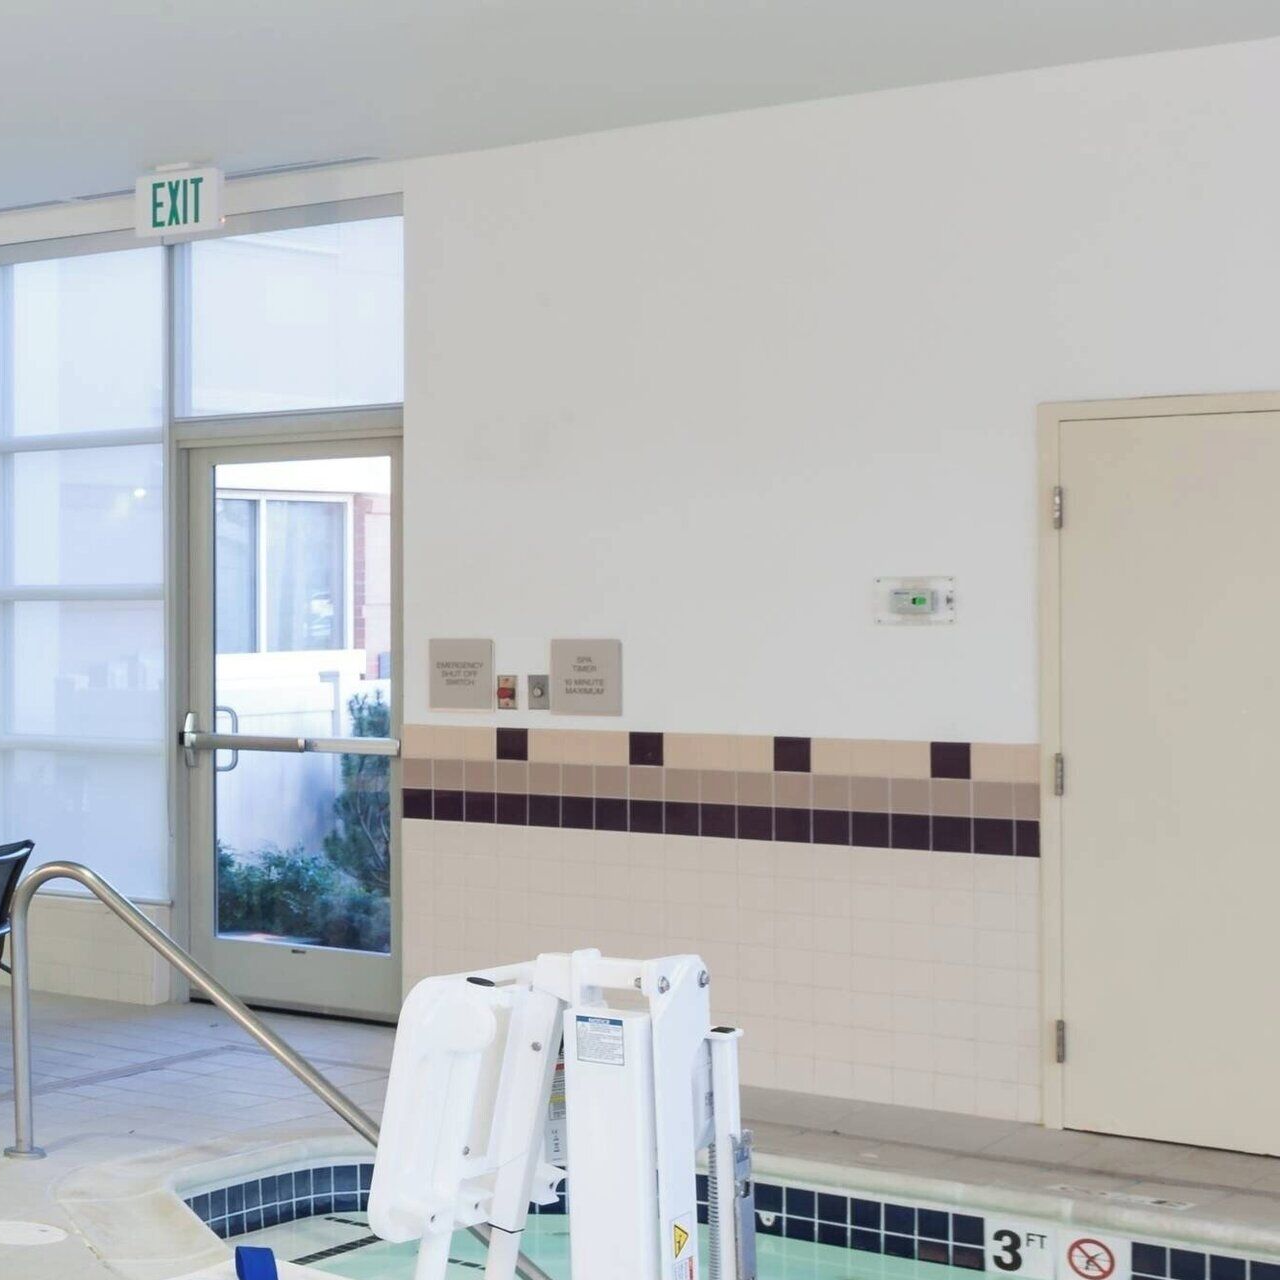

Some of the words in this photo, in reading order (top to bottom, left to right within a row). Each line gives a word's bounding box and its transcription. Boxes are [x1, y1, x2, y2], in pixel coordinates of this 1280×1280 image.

[152, 177, 203, 228] EXIT
[436, 661, 484, 669] EMERGENCY
[565, 687, 605, 695] MAXIMUM
[993, 1229, 1023, 1271] 3
[1026, 1233, 1047, 1249] FT
